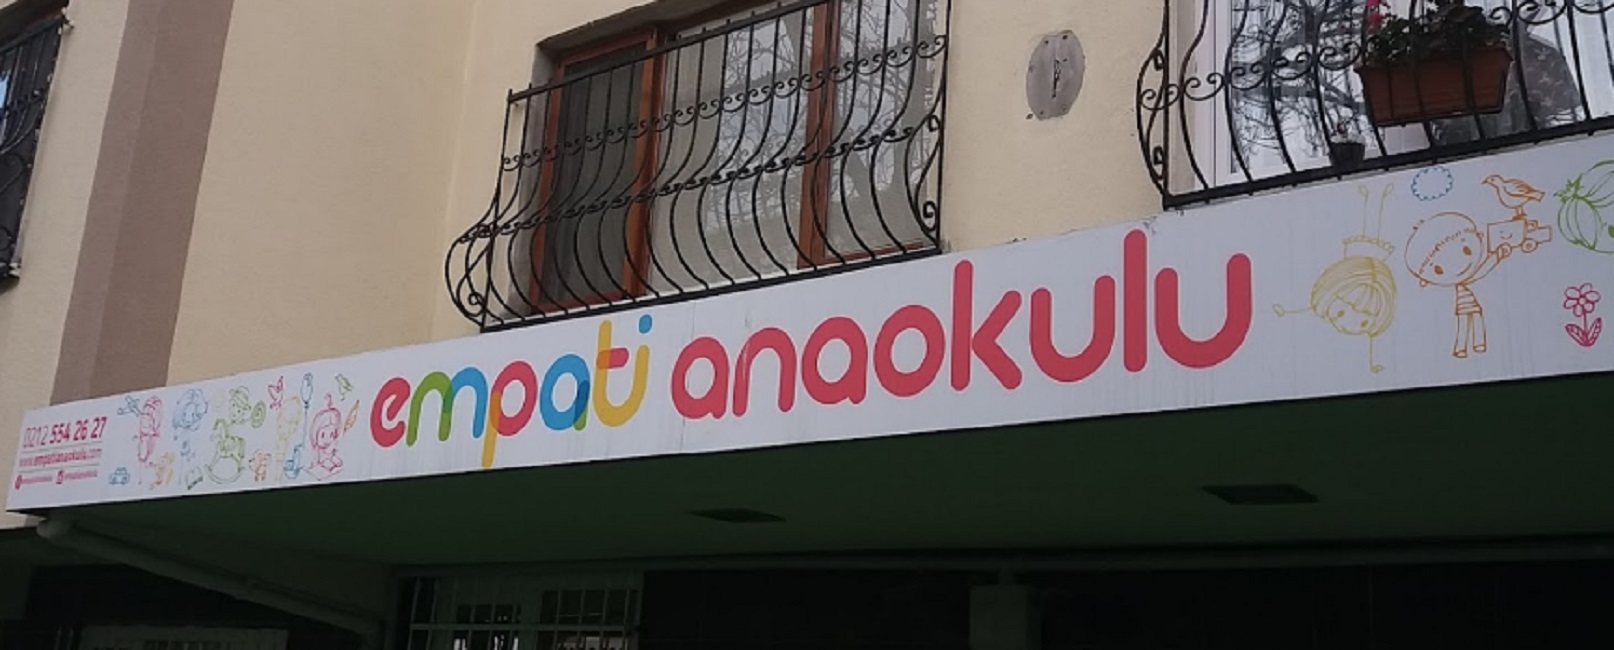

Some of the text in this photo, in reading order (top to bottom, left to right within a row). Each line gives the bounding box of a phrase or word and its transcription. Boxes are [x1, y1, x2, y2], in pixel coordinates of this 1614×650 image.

[370, 229, 1252, 468] empati anaokulu
[23, 416, 107, 448] 0212 554 26 27
